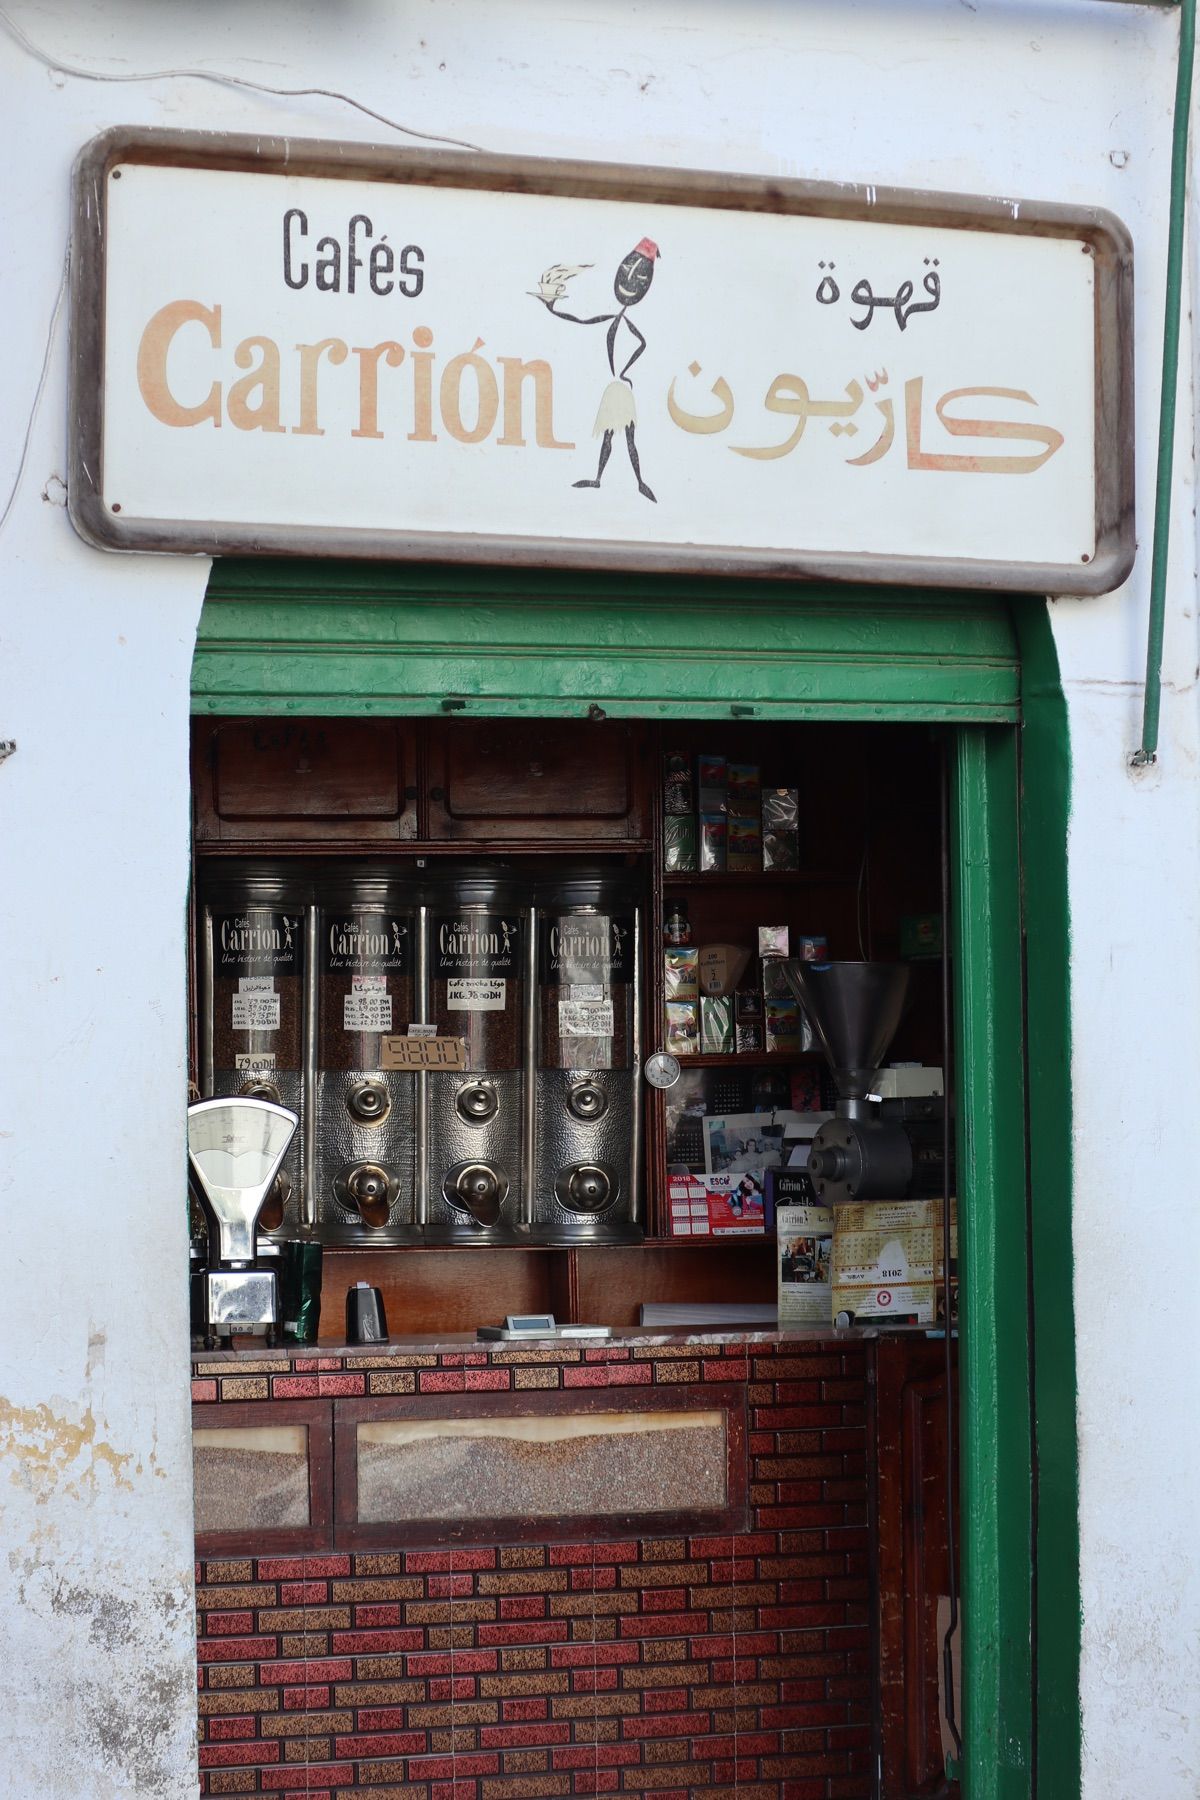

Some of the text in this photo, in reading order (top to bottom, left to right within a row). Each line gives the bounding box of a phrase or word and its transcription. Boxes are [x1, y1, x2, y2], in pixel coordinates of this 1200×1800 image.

[283, 208, 425, 298] Cafés
[815, 256, 941, 332] قهوة
[136, 299, 576, 450] Carrión
[221, 920, 281, 951] Carrion
[330, 924, 389, 955] Carrion
[440, 923, 499, 955] Carrion
[550, 927, 610, 957] Carrion
[329, 957, 344, 967] Une
[440, 957, 453, 967] Une
[882, 1269, 903, 1278] 2018
